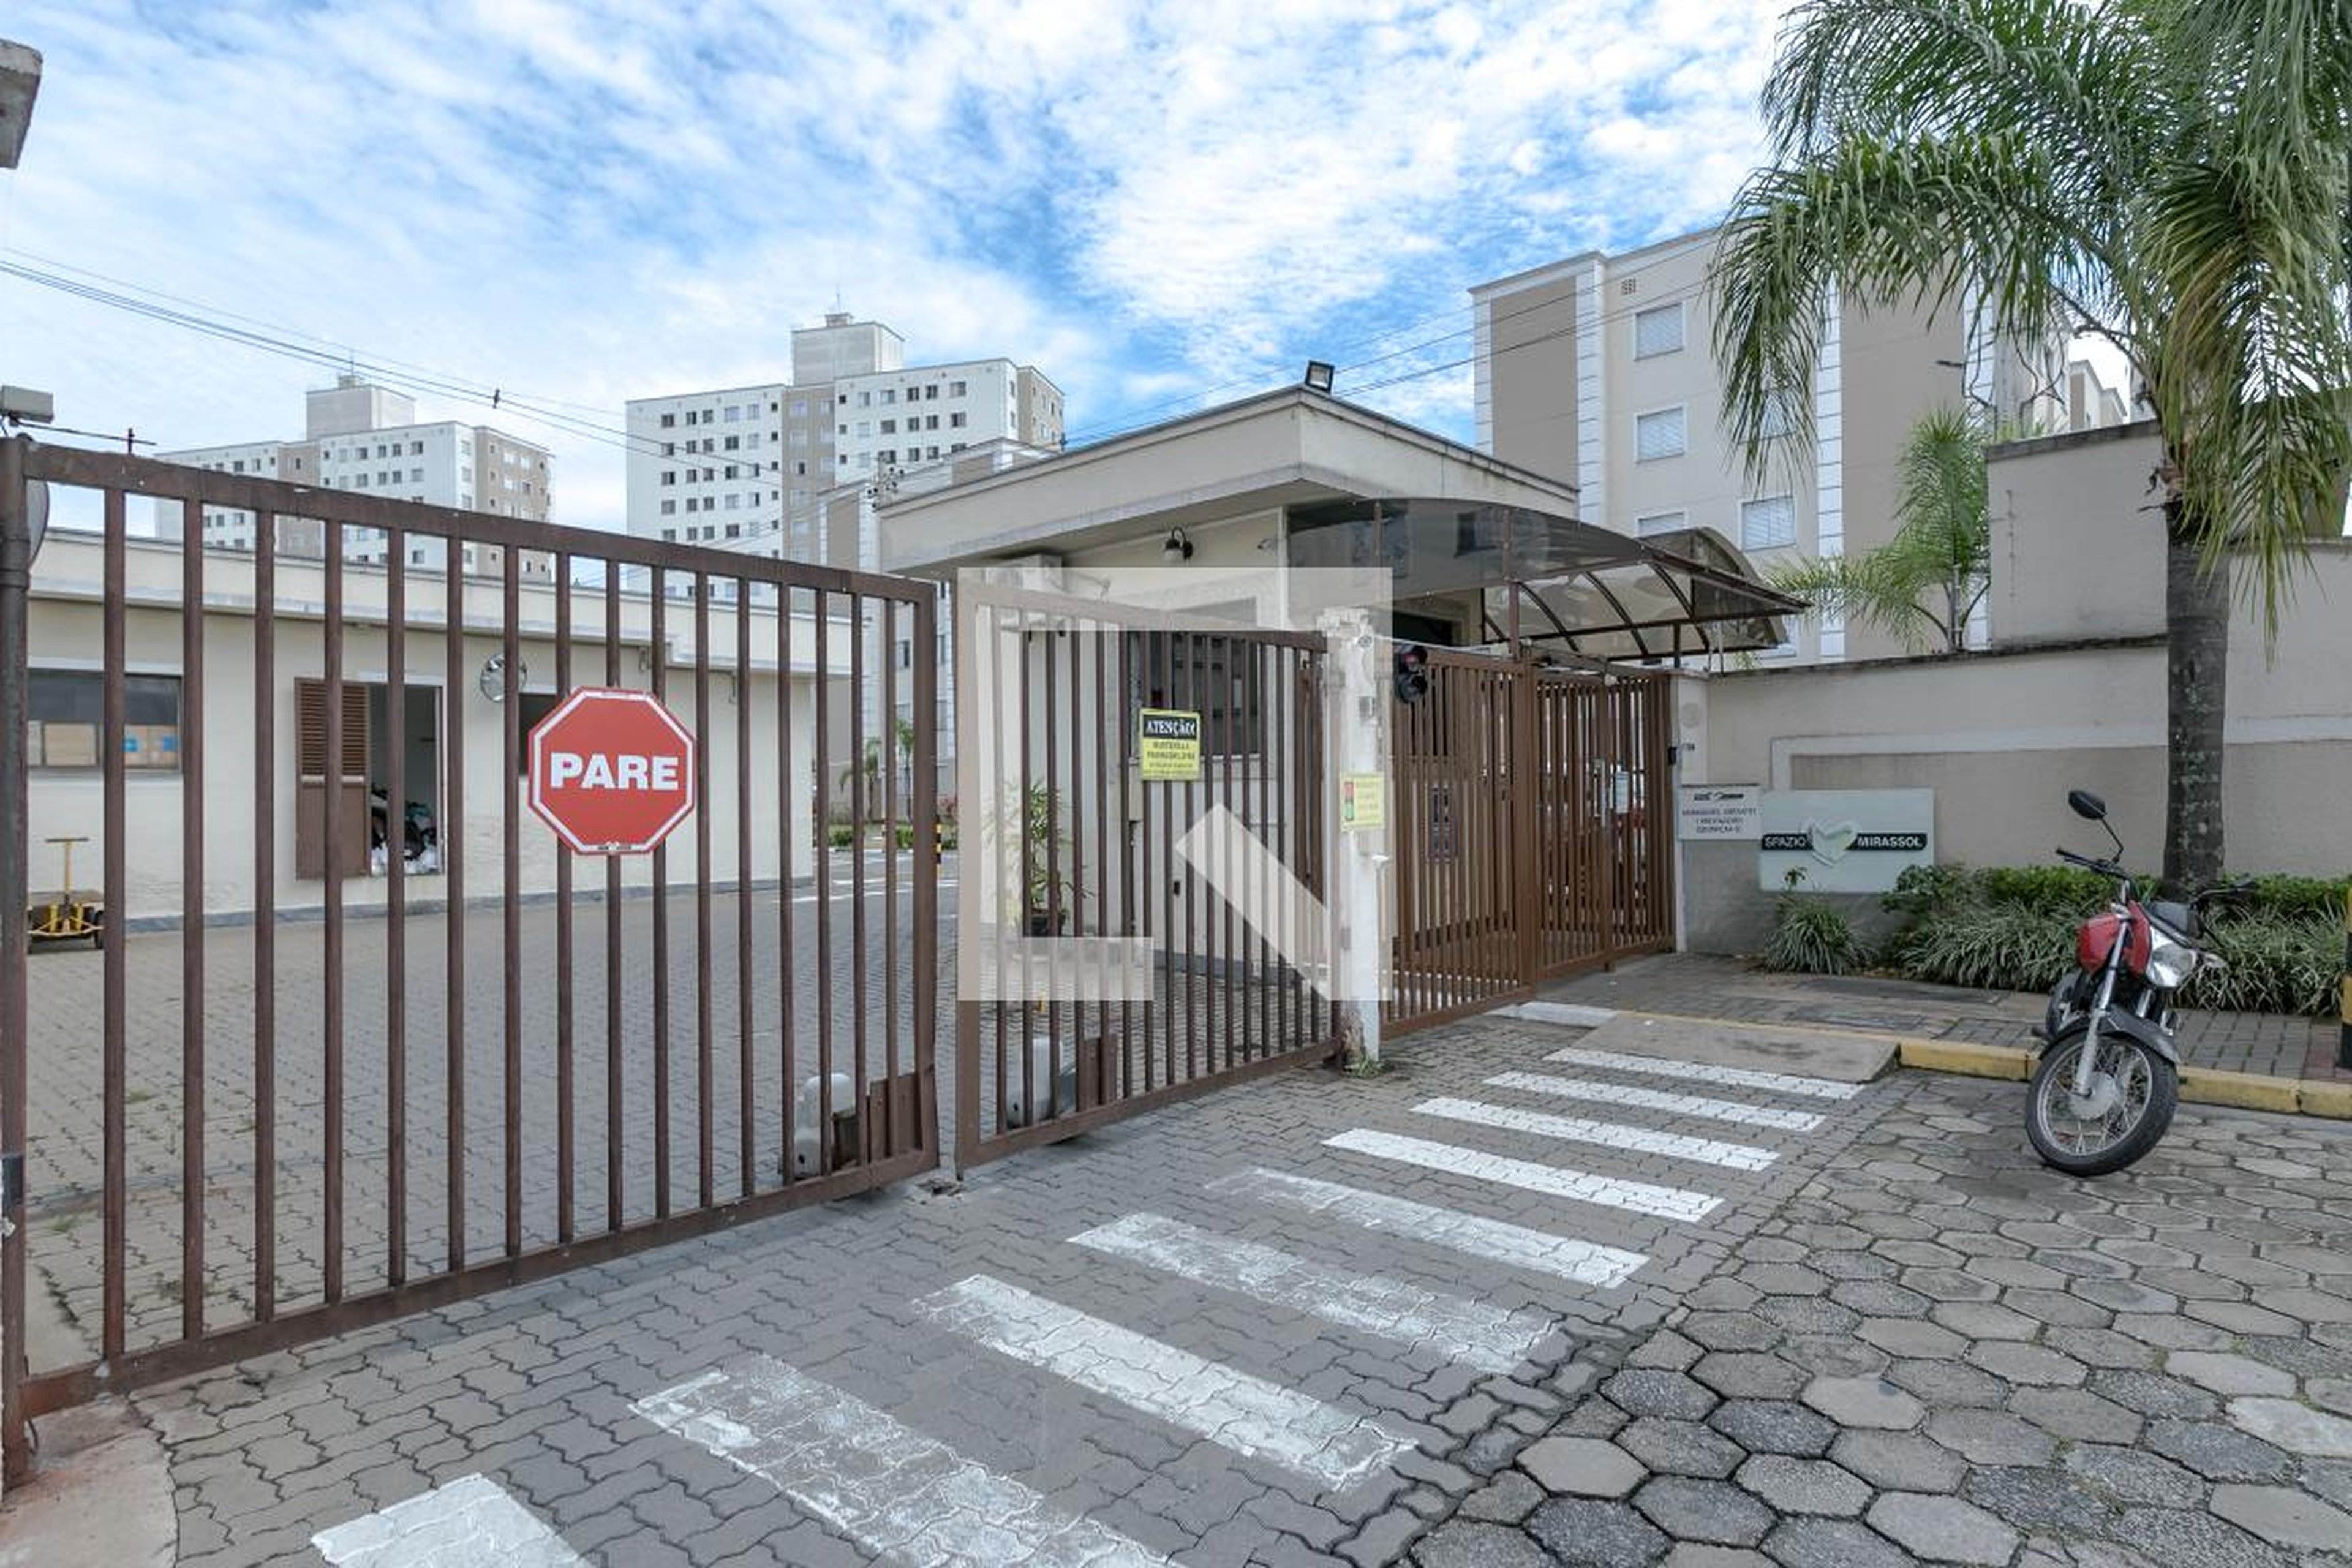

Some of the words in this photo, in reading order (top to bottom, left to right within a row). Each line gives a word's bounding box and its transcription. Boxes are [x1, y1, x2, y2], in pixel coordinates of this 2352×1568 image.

[551, 752, 679, 790] PARE
[1765, 836, 1806, 848] SPAZIO
[1857, 836, 1923, 848] MIRASSOL
